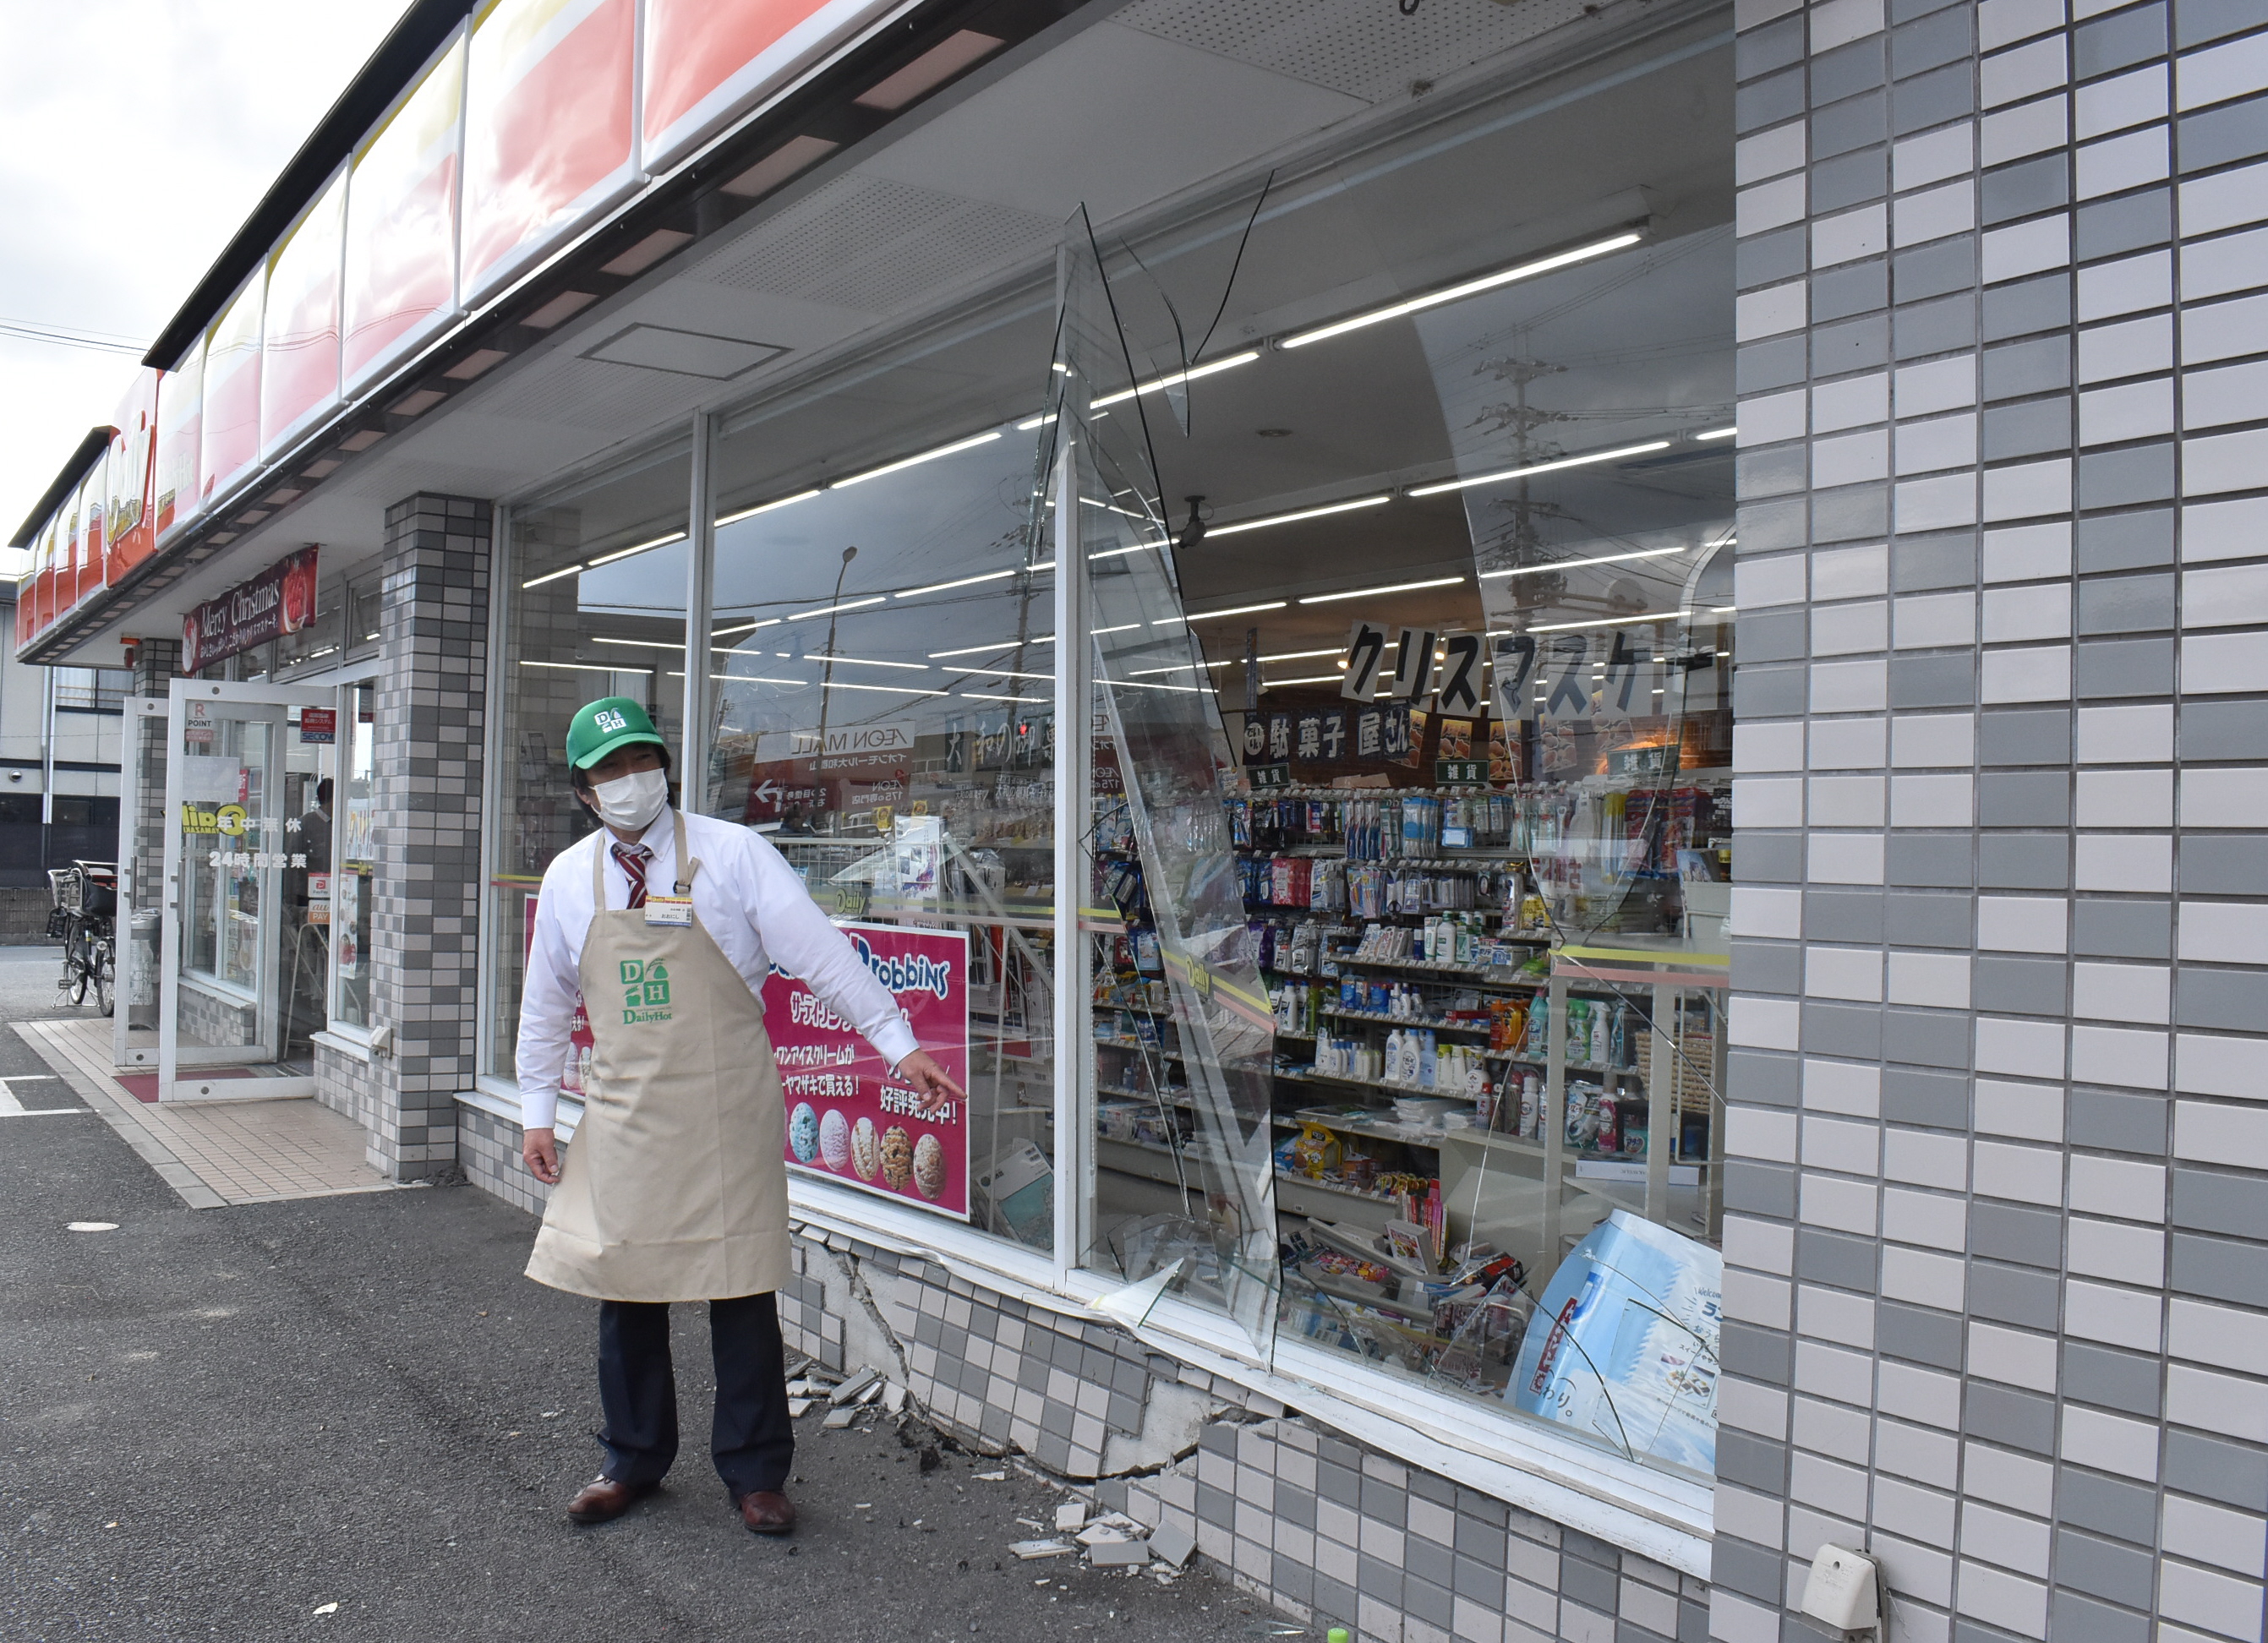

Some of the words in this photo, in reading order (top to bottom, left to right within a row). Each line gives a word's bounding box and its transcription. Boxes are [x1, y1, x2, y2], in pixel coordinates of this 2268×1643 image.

[200, 605, 228, 639] Merry
[231, 578, 280, 626] Christmas
[598, 713, 608, 723] D
[613, 719, 624, 729] H
[303, 732, 334, 741] SECOM
[1269, 710, 1410, 759] 駄菓子屋さん
[1624, 751, 1662, 772] 雑貨
[1256, 768, 1281, 784] 雑貨
[1447, 764, 1478, 780] 雑貨
[217, 816, 302, 833] 年中無休
[209, 851, 307, 869] 24時間営業
[312, 903, 330, 911] au
[835, 887, 867, 914] Daily
[623, 963, 641, 981] D
[1185, 953, 1210, 996] Daily
[647, 984, 665, 1001] H
[622, 1009, 672, 1025] DailyHot
[773, 1044, 855, 1066] ワンアイスクリームが
